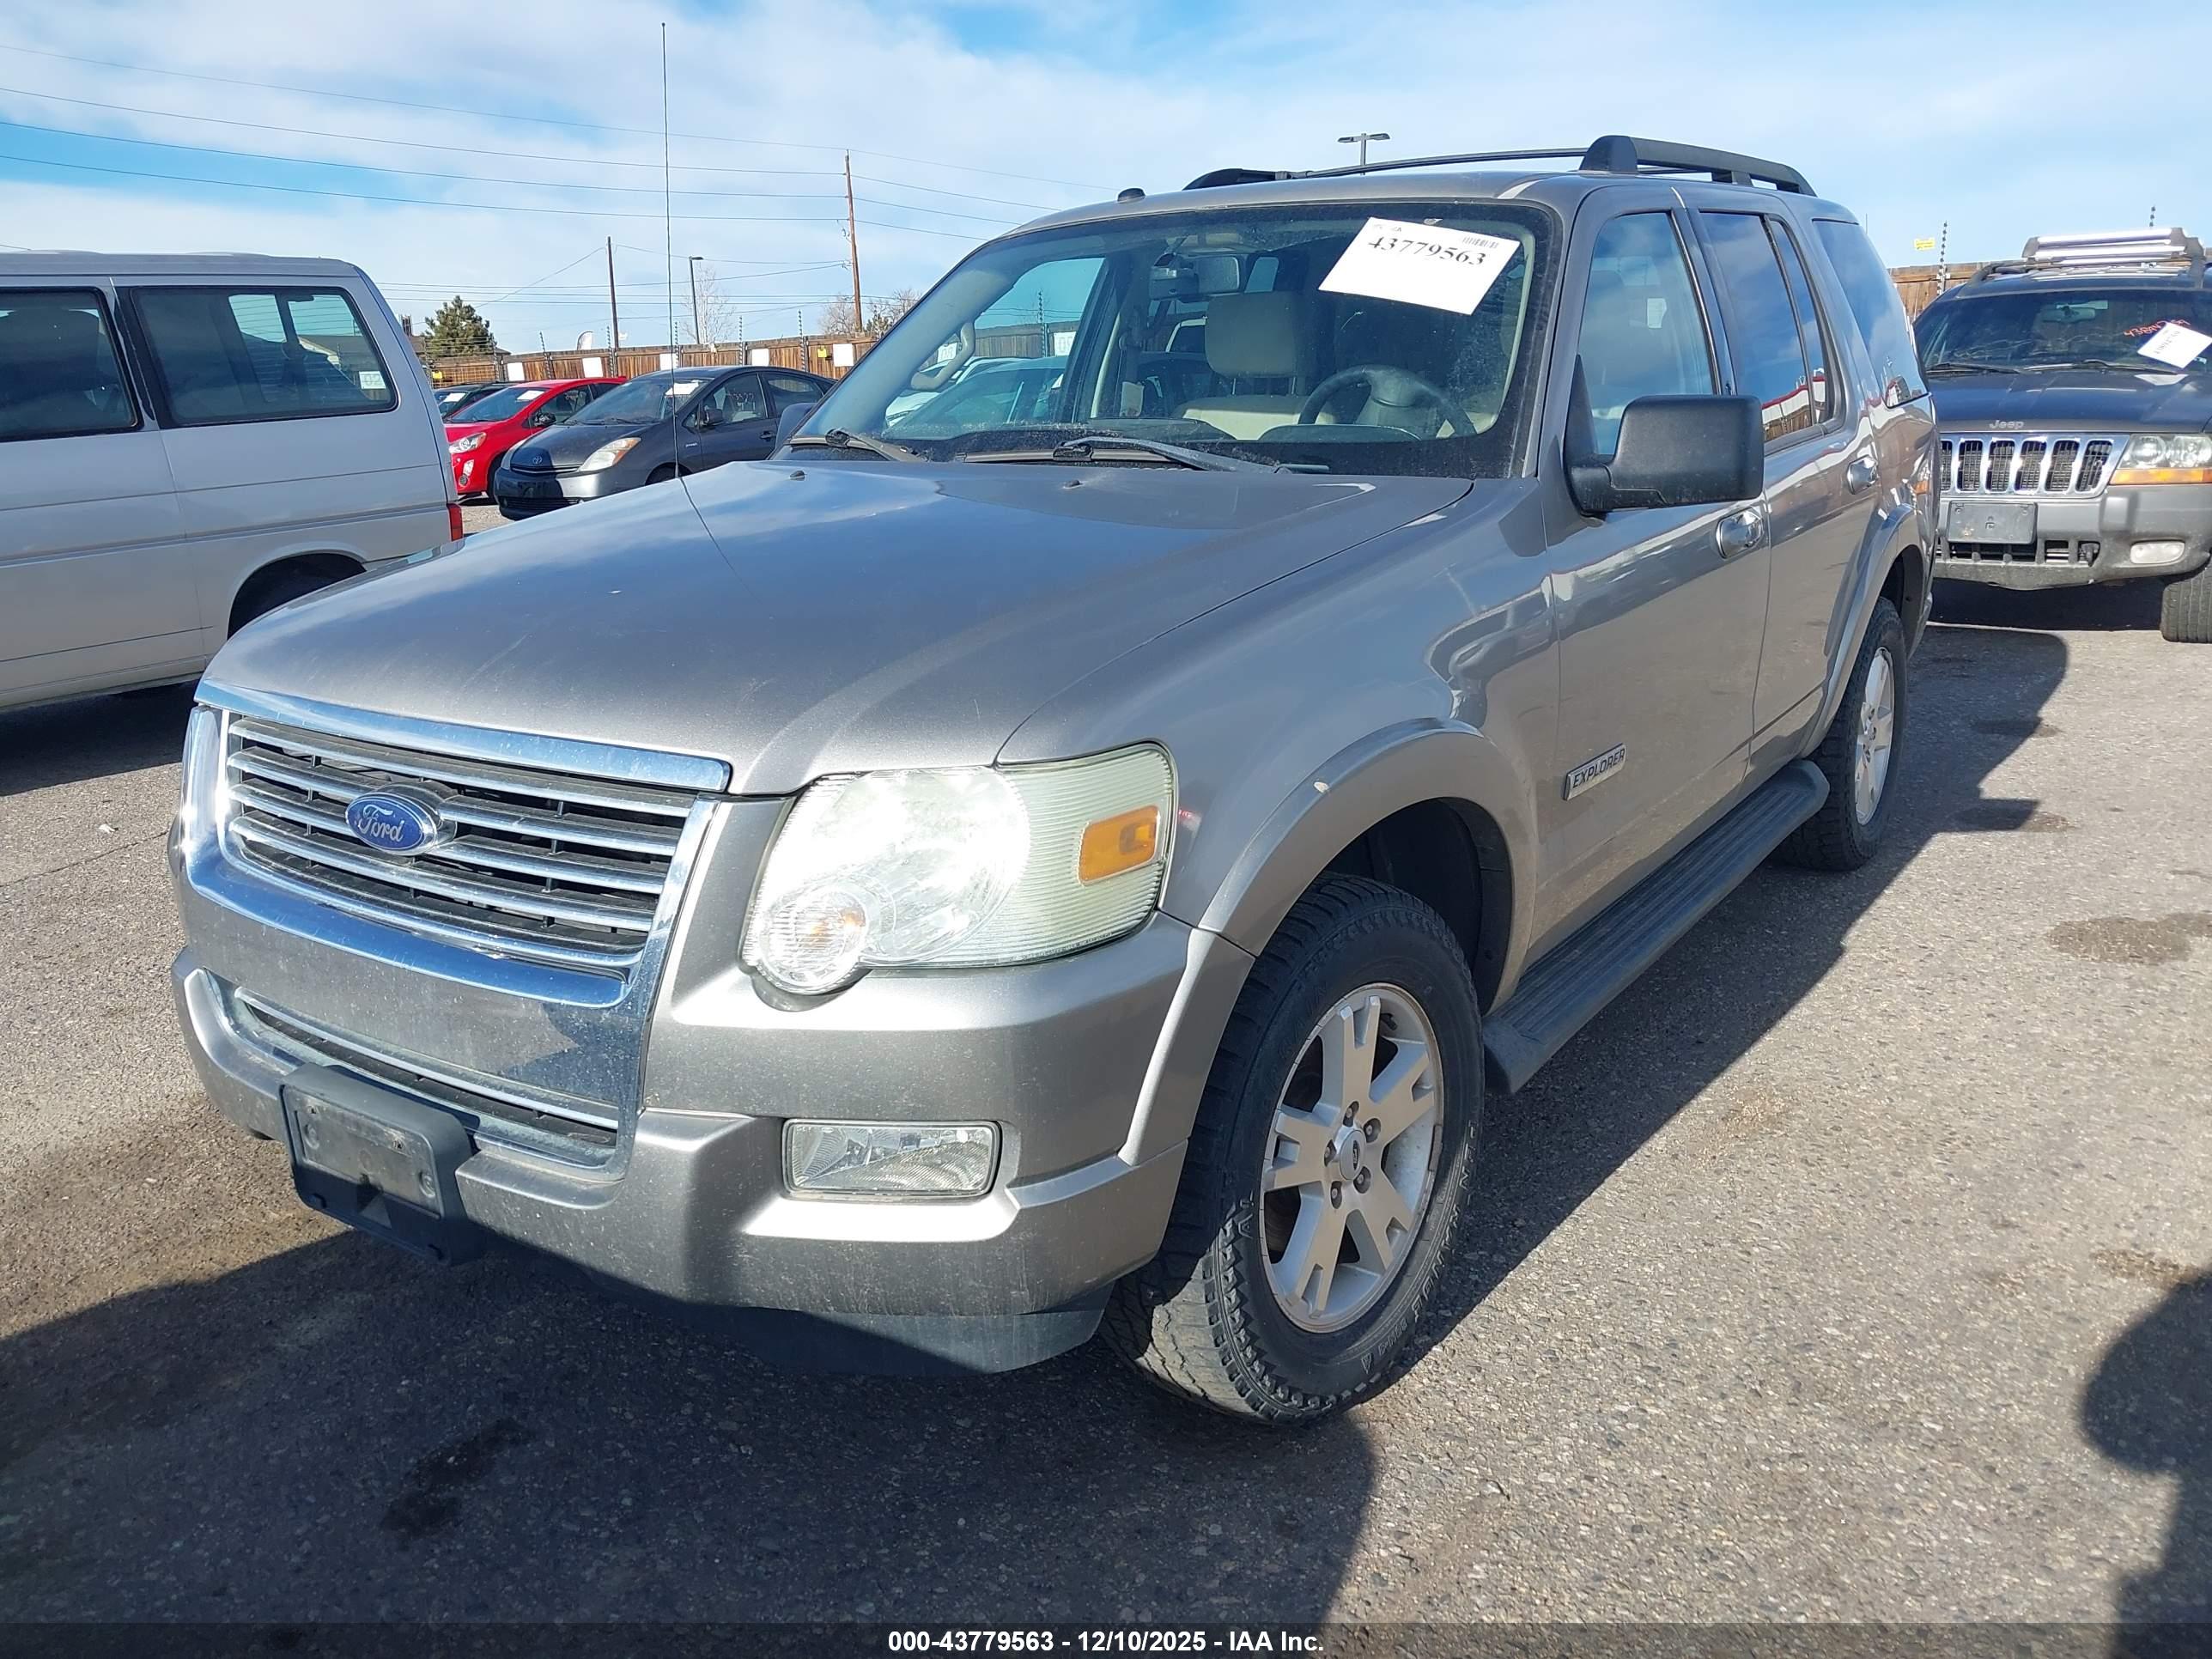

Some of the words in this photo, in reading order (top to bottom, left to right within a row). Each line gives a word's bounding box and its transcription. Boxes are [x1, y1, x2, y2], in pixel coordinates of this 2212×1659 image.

[1367, 235, 1486, 265] 43779563
[1989, 419, 2025, 430] Jeep
[1572, 748, 1626, 788] EXPLORER
[358, 804, 405, 842] Ford
